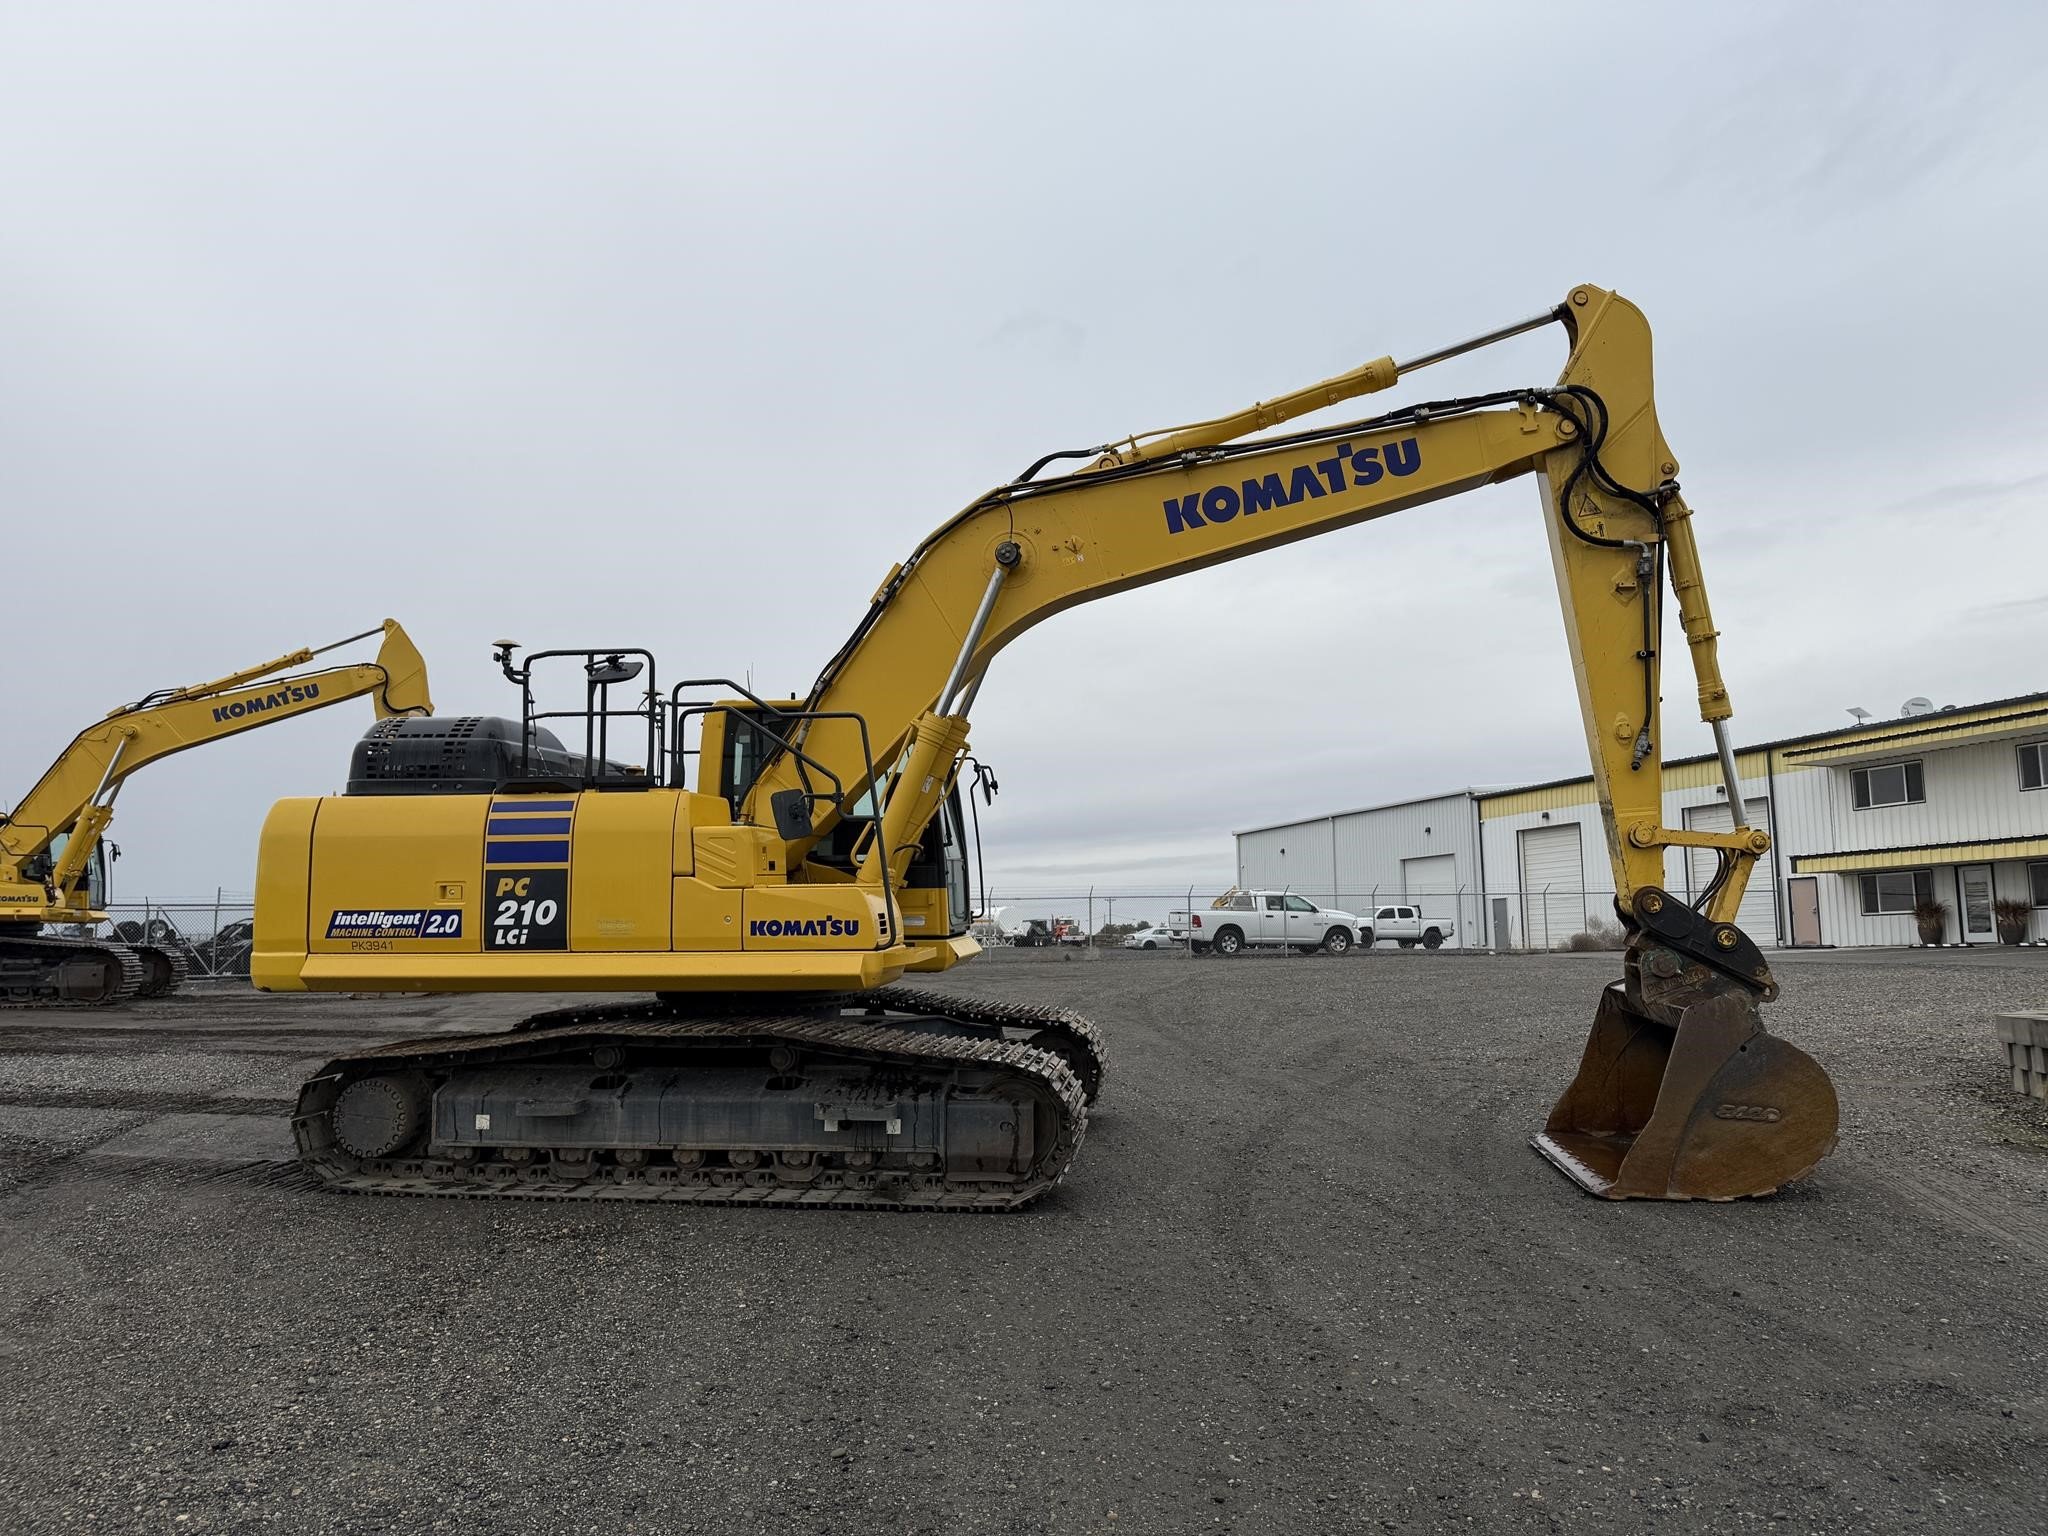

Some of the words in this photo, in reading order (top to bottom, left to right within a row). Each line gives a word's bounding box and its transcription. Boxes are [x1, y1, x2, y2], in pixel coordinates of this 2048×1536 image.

[1163, 438, 1421, 534] KOMATSU
[212, 683, 320, 723] KOMATSU
[495, 877, 531, 897] PC
[0, 894, 39, 903] OMATSU
[335, 911, 421, 929] intelligent
[426, 914, 459, 934] 2.0
[493, 899, 558, 926] 210
[331, 927, 373, 937] MACHINE
[375, 927, 417, 937] CONTROL
[750, 915, 859, 936] KOMATSU
[351, 941, 393, 951] PK3941
[495, 928, 529, 945] LCi
